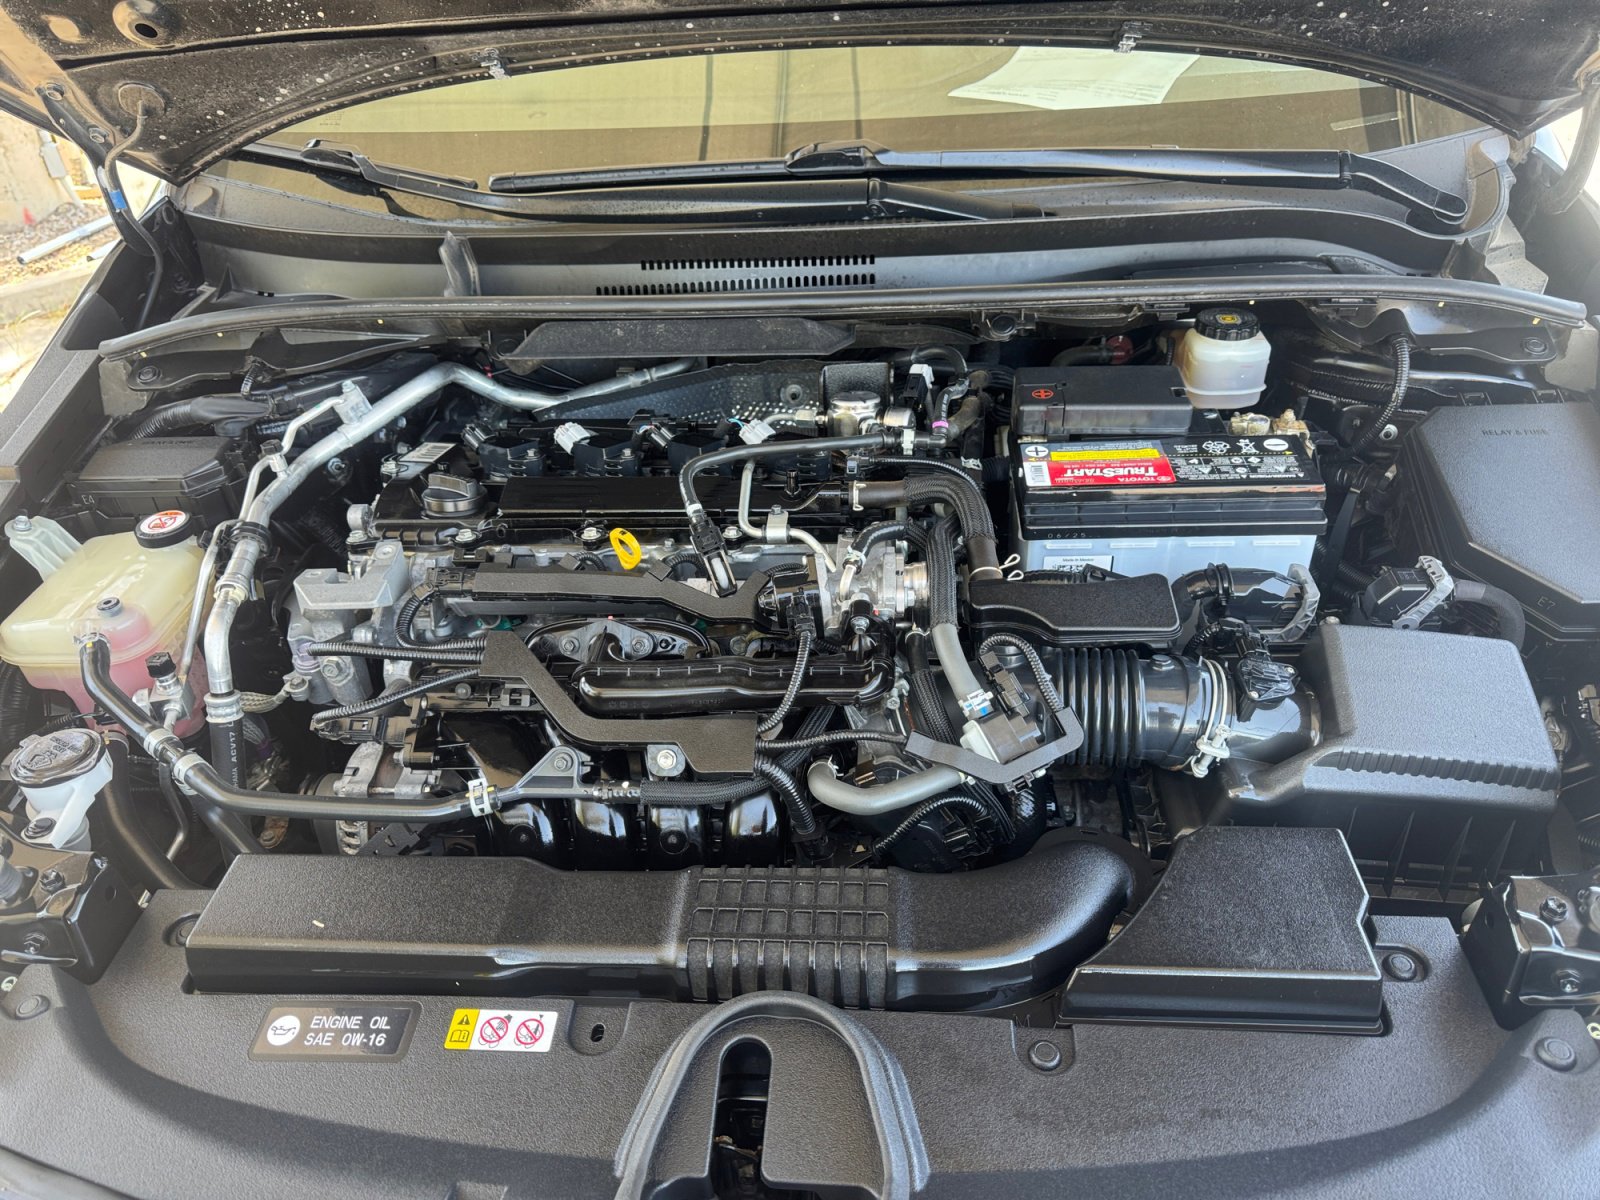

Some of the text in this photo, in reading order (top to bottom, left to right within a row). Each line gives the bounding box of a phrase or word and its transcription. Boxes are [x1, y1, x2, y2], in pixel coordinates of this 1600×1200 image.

[1481, 429, 1512, 437] RELAY
[229, 731, 238, 763] ACV17
[310, 1016, 391, 1029] ENGINE OIL
[304, 1032, 387, 1046] SAE 0W-16
